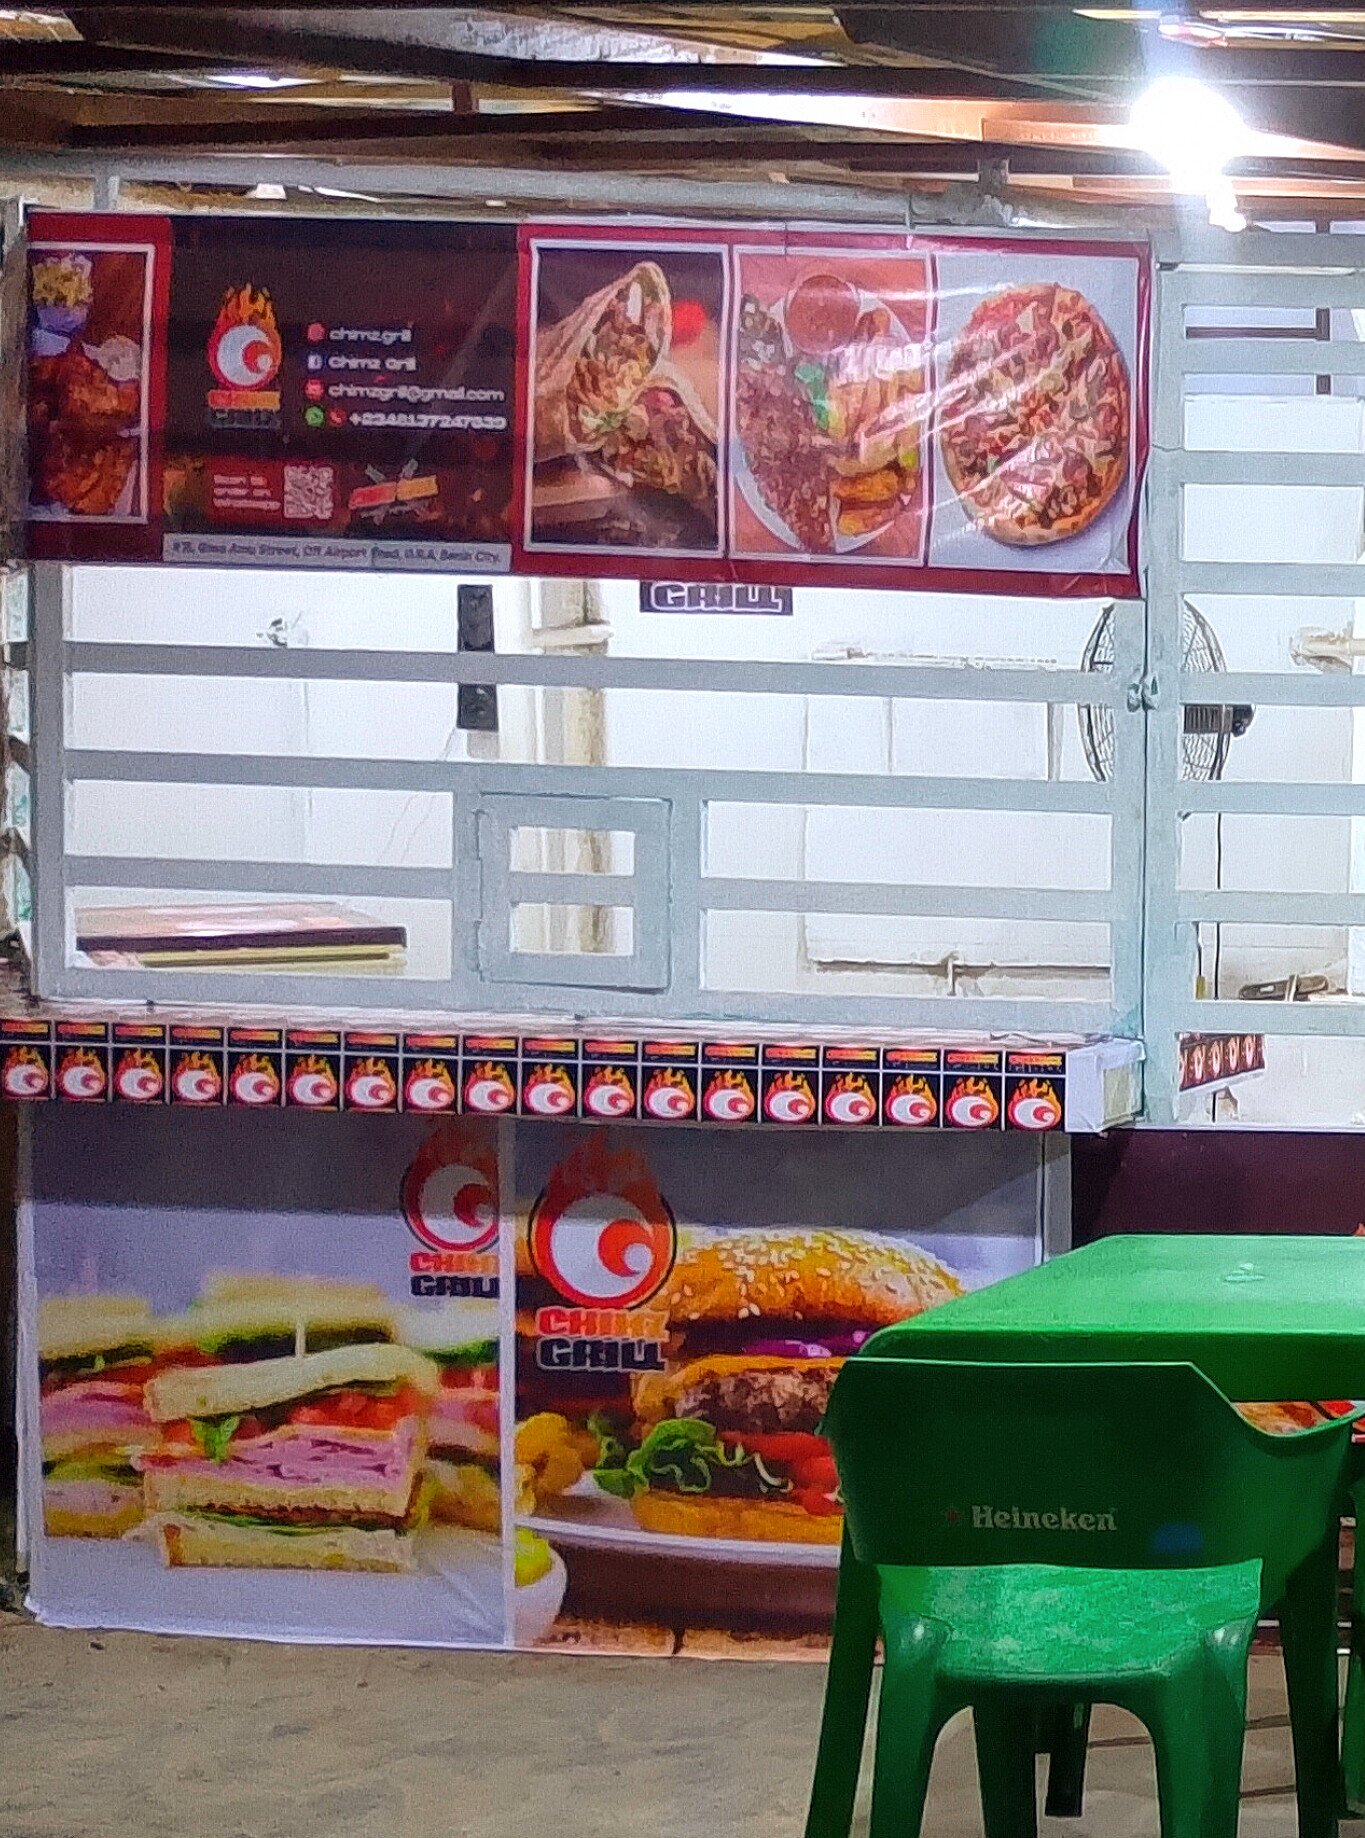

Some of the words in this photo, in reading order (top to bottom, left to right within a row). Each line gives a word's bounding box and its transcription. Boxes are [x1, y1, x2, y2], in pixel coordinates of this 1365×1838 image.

[649, 581, 783, 613] GRILL
[535, 1305, 671, 1343] CHIMZ
[536, 1336, 668, 1373] GRILL
[971, 1504, 1118, 1532] Heineken
